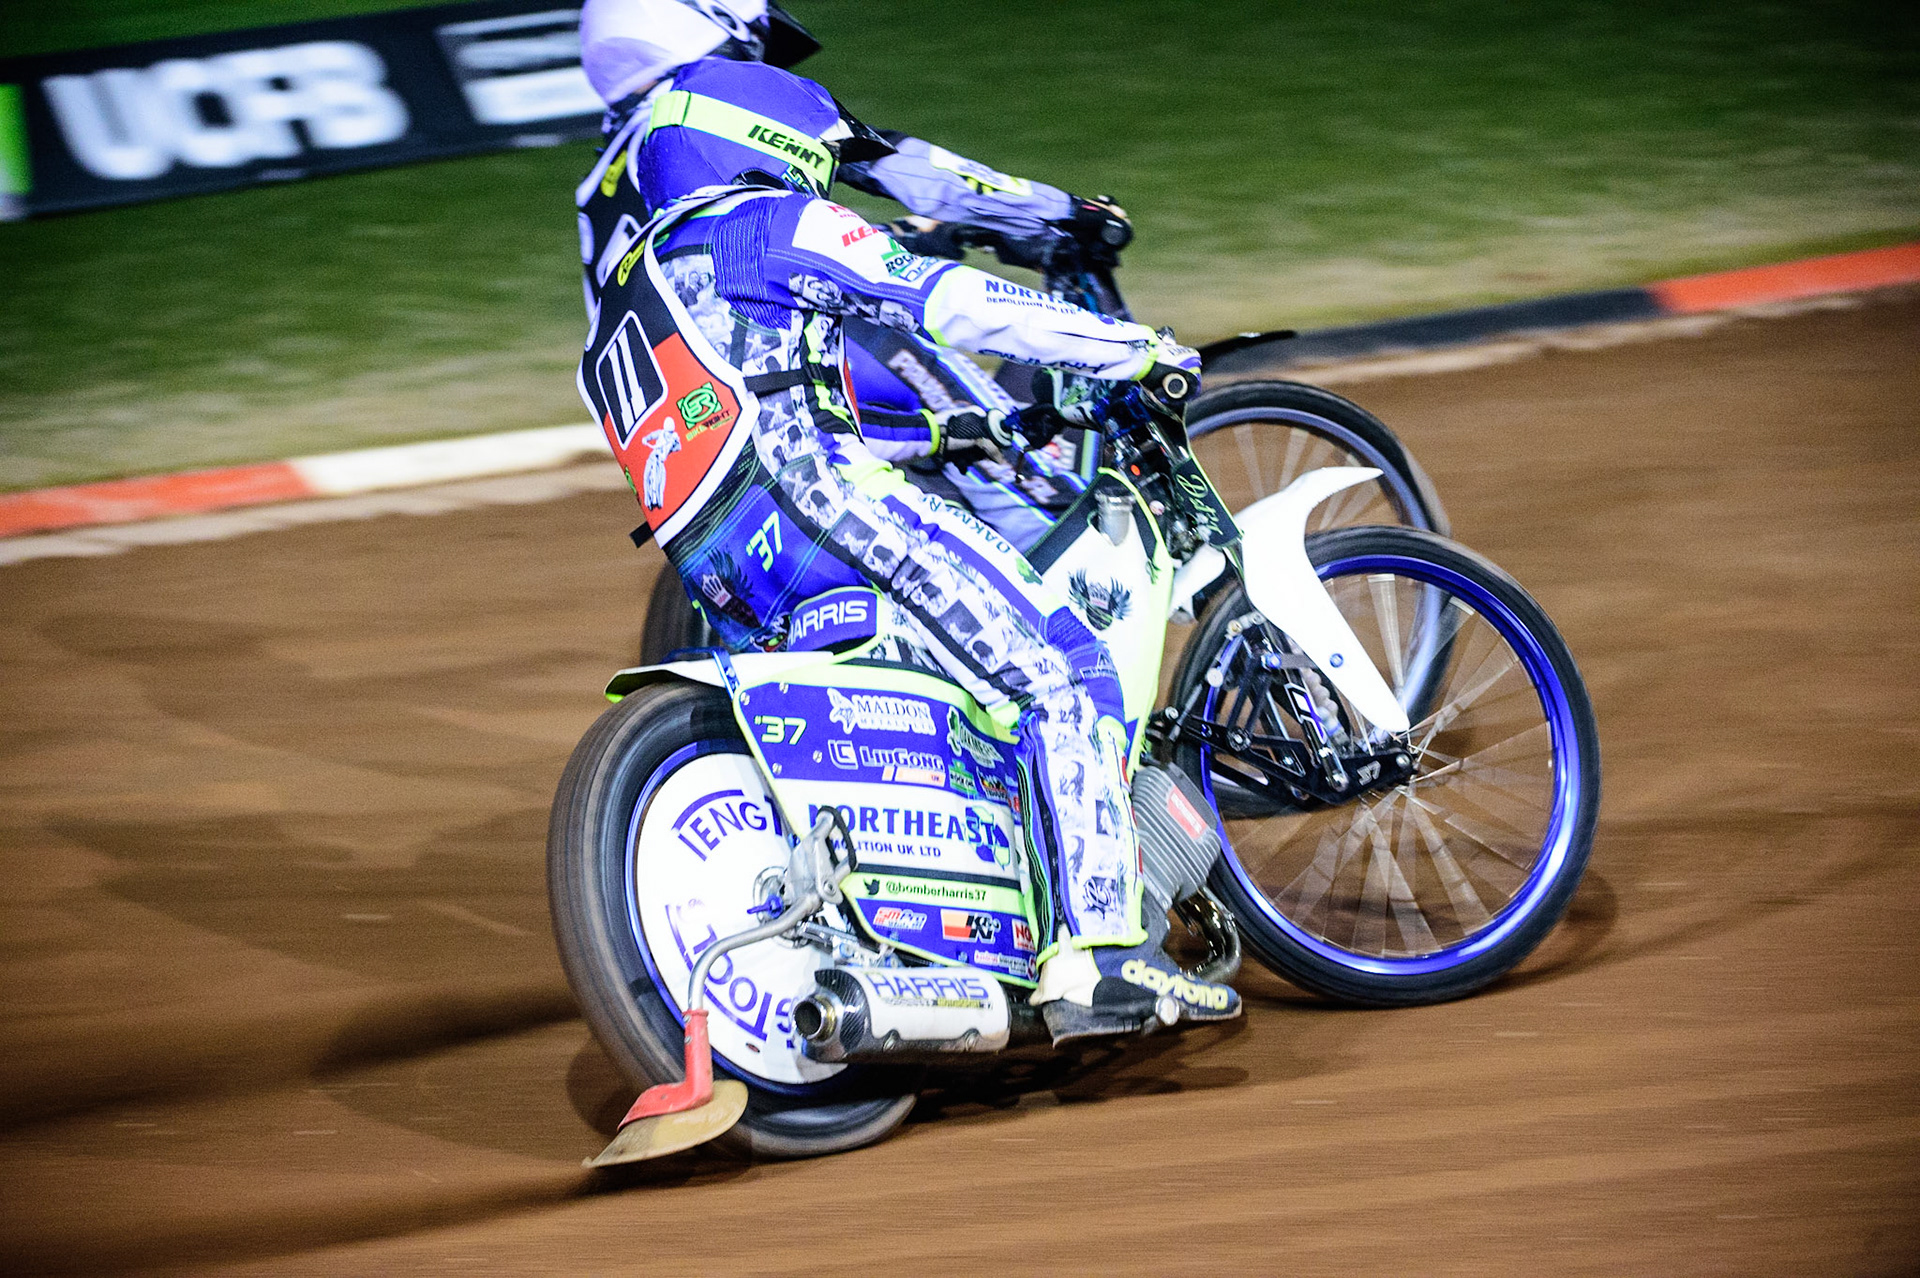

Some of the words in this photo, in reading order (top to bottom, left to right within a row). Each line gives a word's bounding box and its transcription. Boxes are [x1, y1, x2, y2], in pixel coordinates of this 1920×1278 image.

[748, 125, 825, 169] KENNY
[986, 296, 1043, 308] DEMOLITION
[607, 326, 648, 436] 11
[856, 699, 930, 719] MALDON
[897, 843, 915, 855] UK
[919, 845, 942, 858] LTD
[886, 880, 987, 901] @bomberharris37
[865, 973, 989, 1000] HARRIS
[1121, 959, 1229, 1011] daytona
